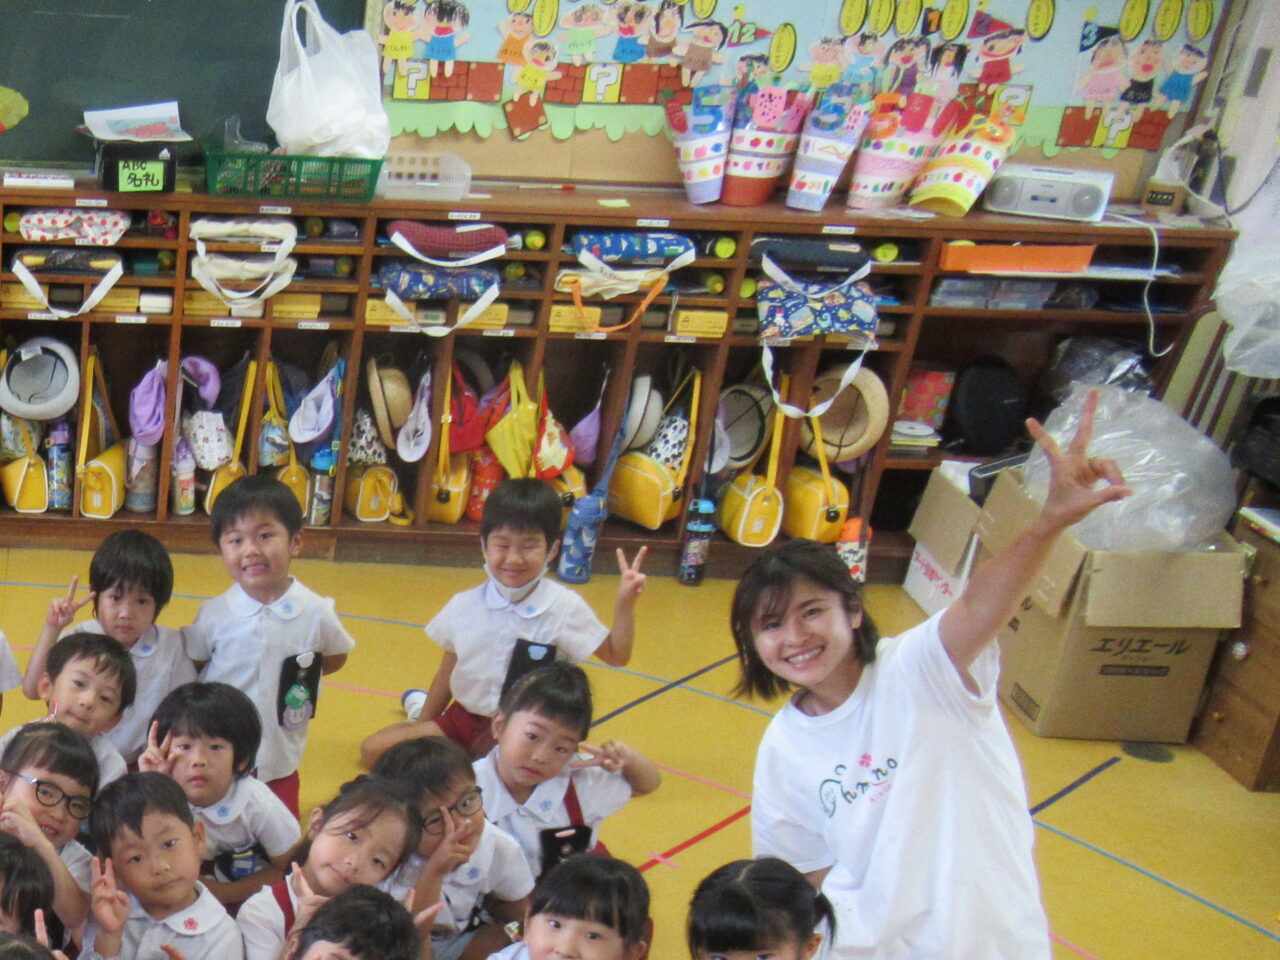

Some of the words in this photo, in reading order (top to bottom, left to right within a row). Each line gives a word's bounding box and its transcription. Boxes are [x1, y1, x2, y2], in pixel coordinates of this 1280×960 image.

[728, 22, 756, 44] 12
[1081, 23, 1100, 49] 3
[122, 160, 148, 171] ABC
[1090, 638, 1193, 657] エリエール
